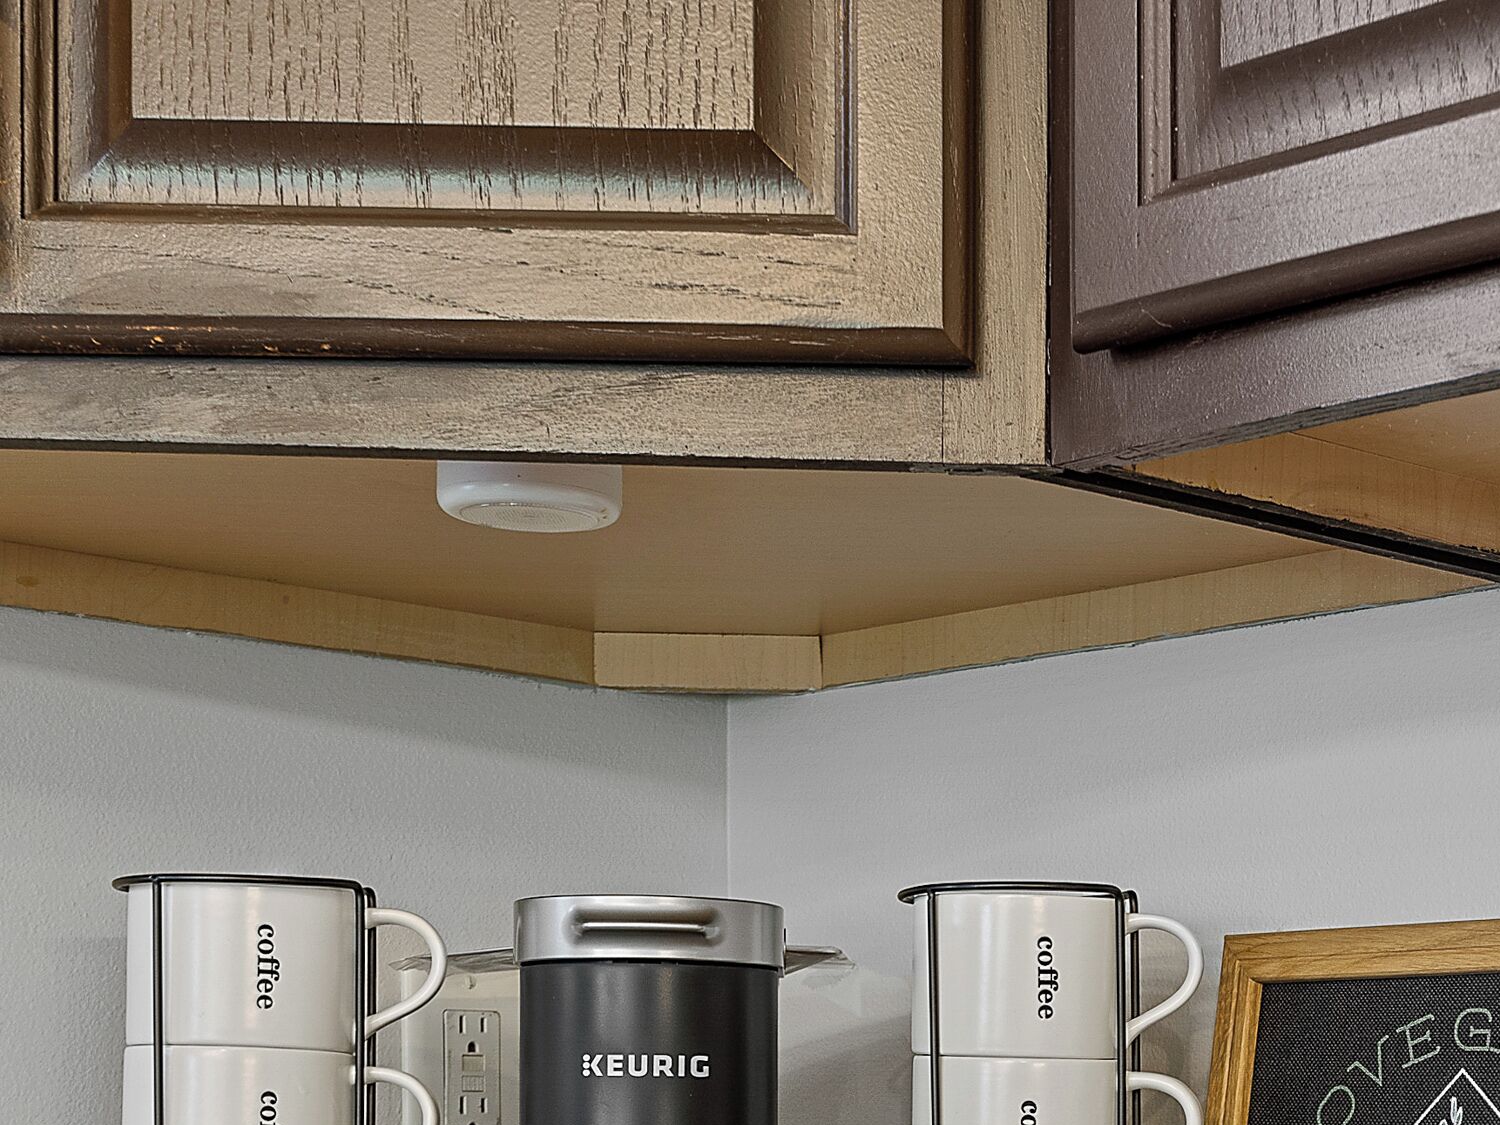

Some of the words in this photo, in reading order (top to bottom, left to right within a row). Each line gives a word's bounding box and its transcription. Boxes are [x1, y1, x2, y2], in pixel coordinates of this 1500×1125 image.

[256, 923, 281, 1010] coffee
[1036, 936, 1059, 1020] coffee
[582, 1053, 710, 1078] KEURIG
